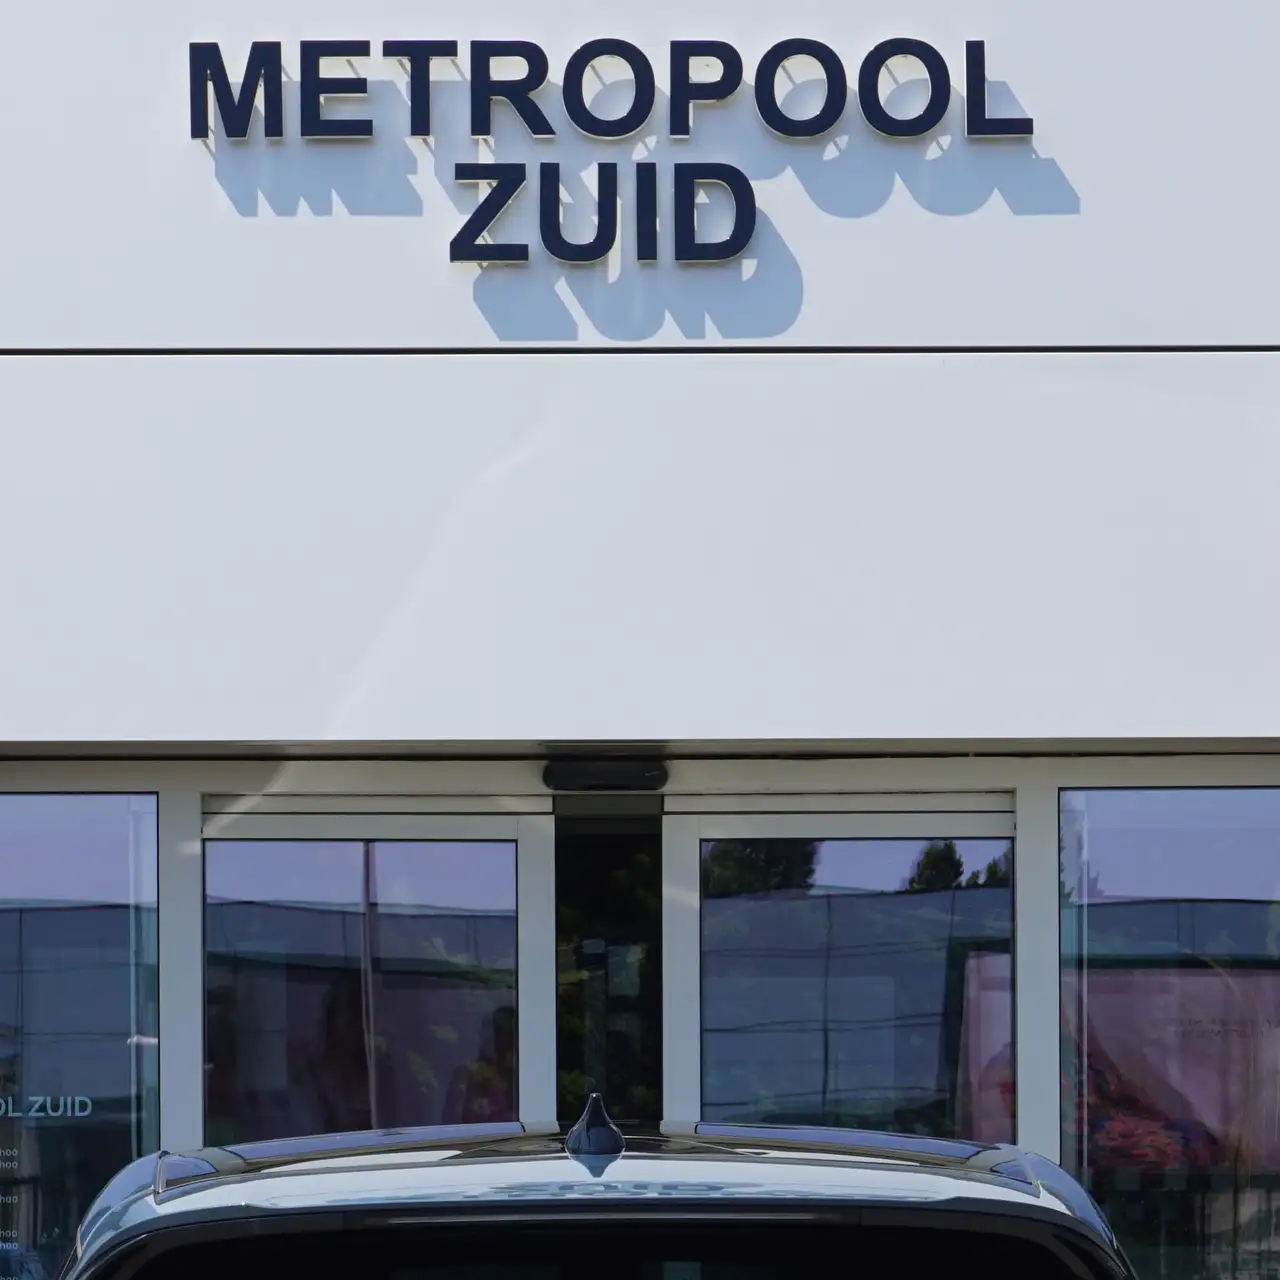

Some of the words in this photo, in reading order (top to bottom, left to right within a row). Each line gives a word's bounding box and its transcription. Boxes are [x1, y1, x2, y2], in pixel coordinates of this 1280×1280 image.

[188, 37, 1035, 139] METROPOOL
[448, 160, 758, 263] ZUID
[28, 1096, 92, 1117] ZUID
